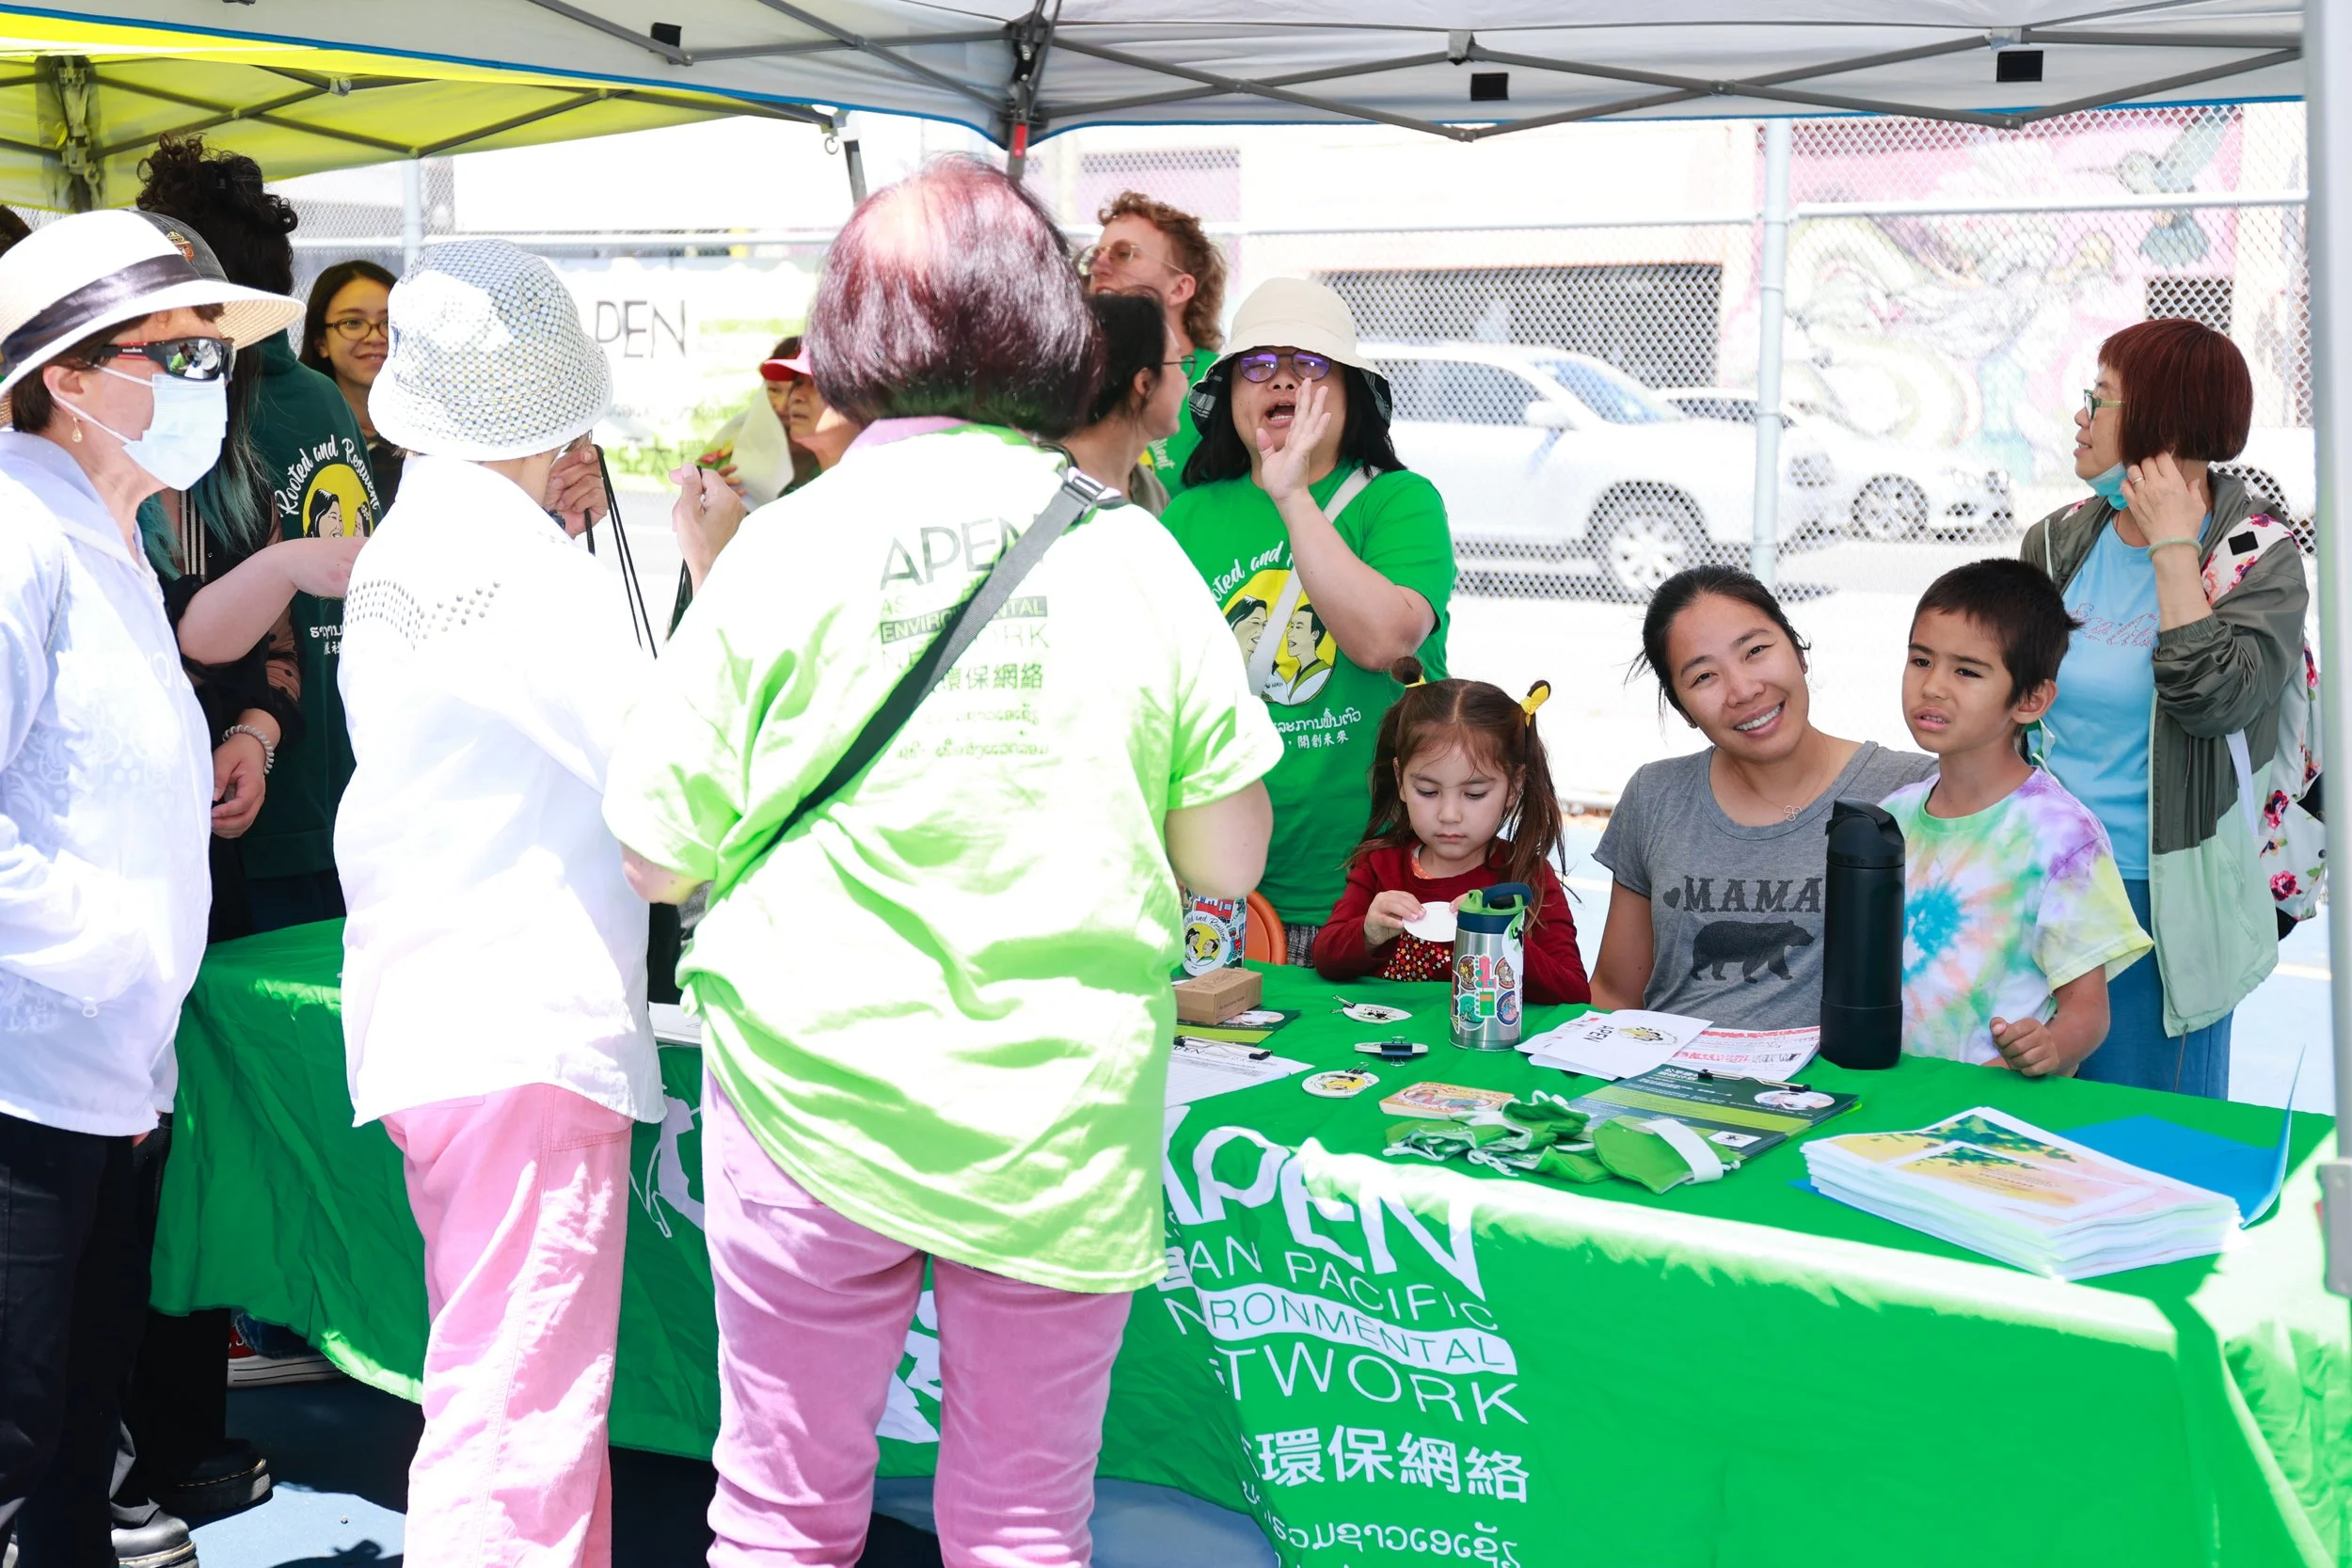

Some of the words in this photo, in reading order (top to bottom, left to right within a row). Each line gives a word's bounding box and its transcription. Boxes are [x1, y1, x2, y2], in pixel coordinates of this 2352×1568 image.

[274, 449, 313, 518] Rooted
[313, 435, 339, 463] and
[1211, 559, 1246, 602] oted
[1249, 540, 1284, 572] and
[1683, 875, 1823, 914] MAMA
[1284, 1251, 1499, 1332] PACIFIC
[1241, 1424, 1531, 1504] 環保網絡
